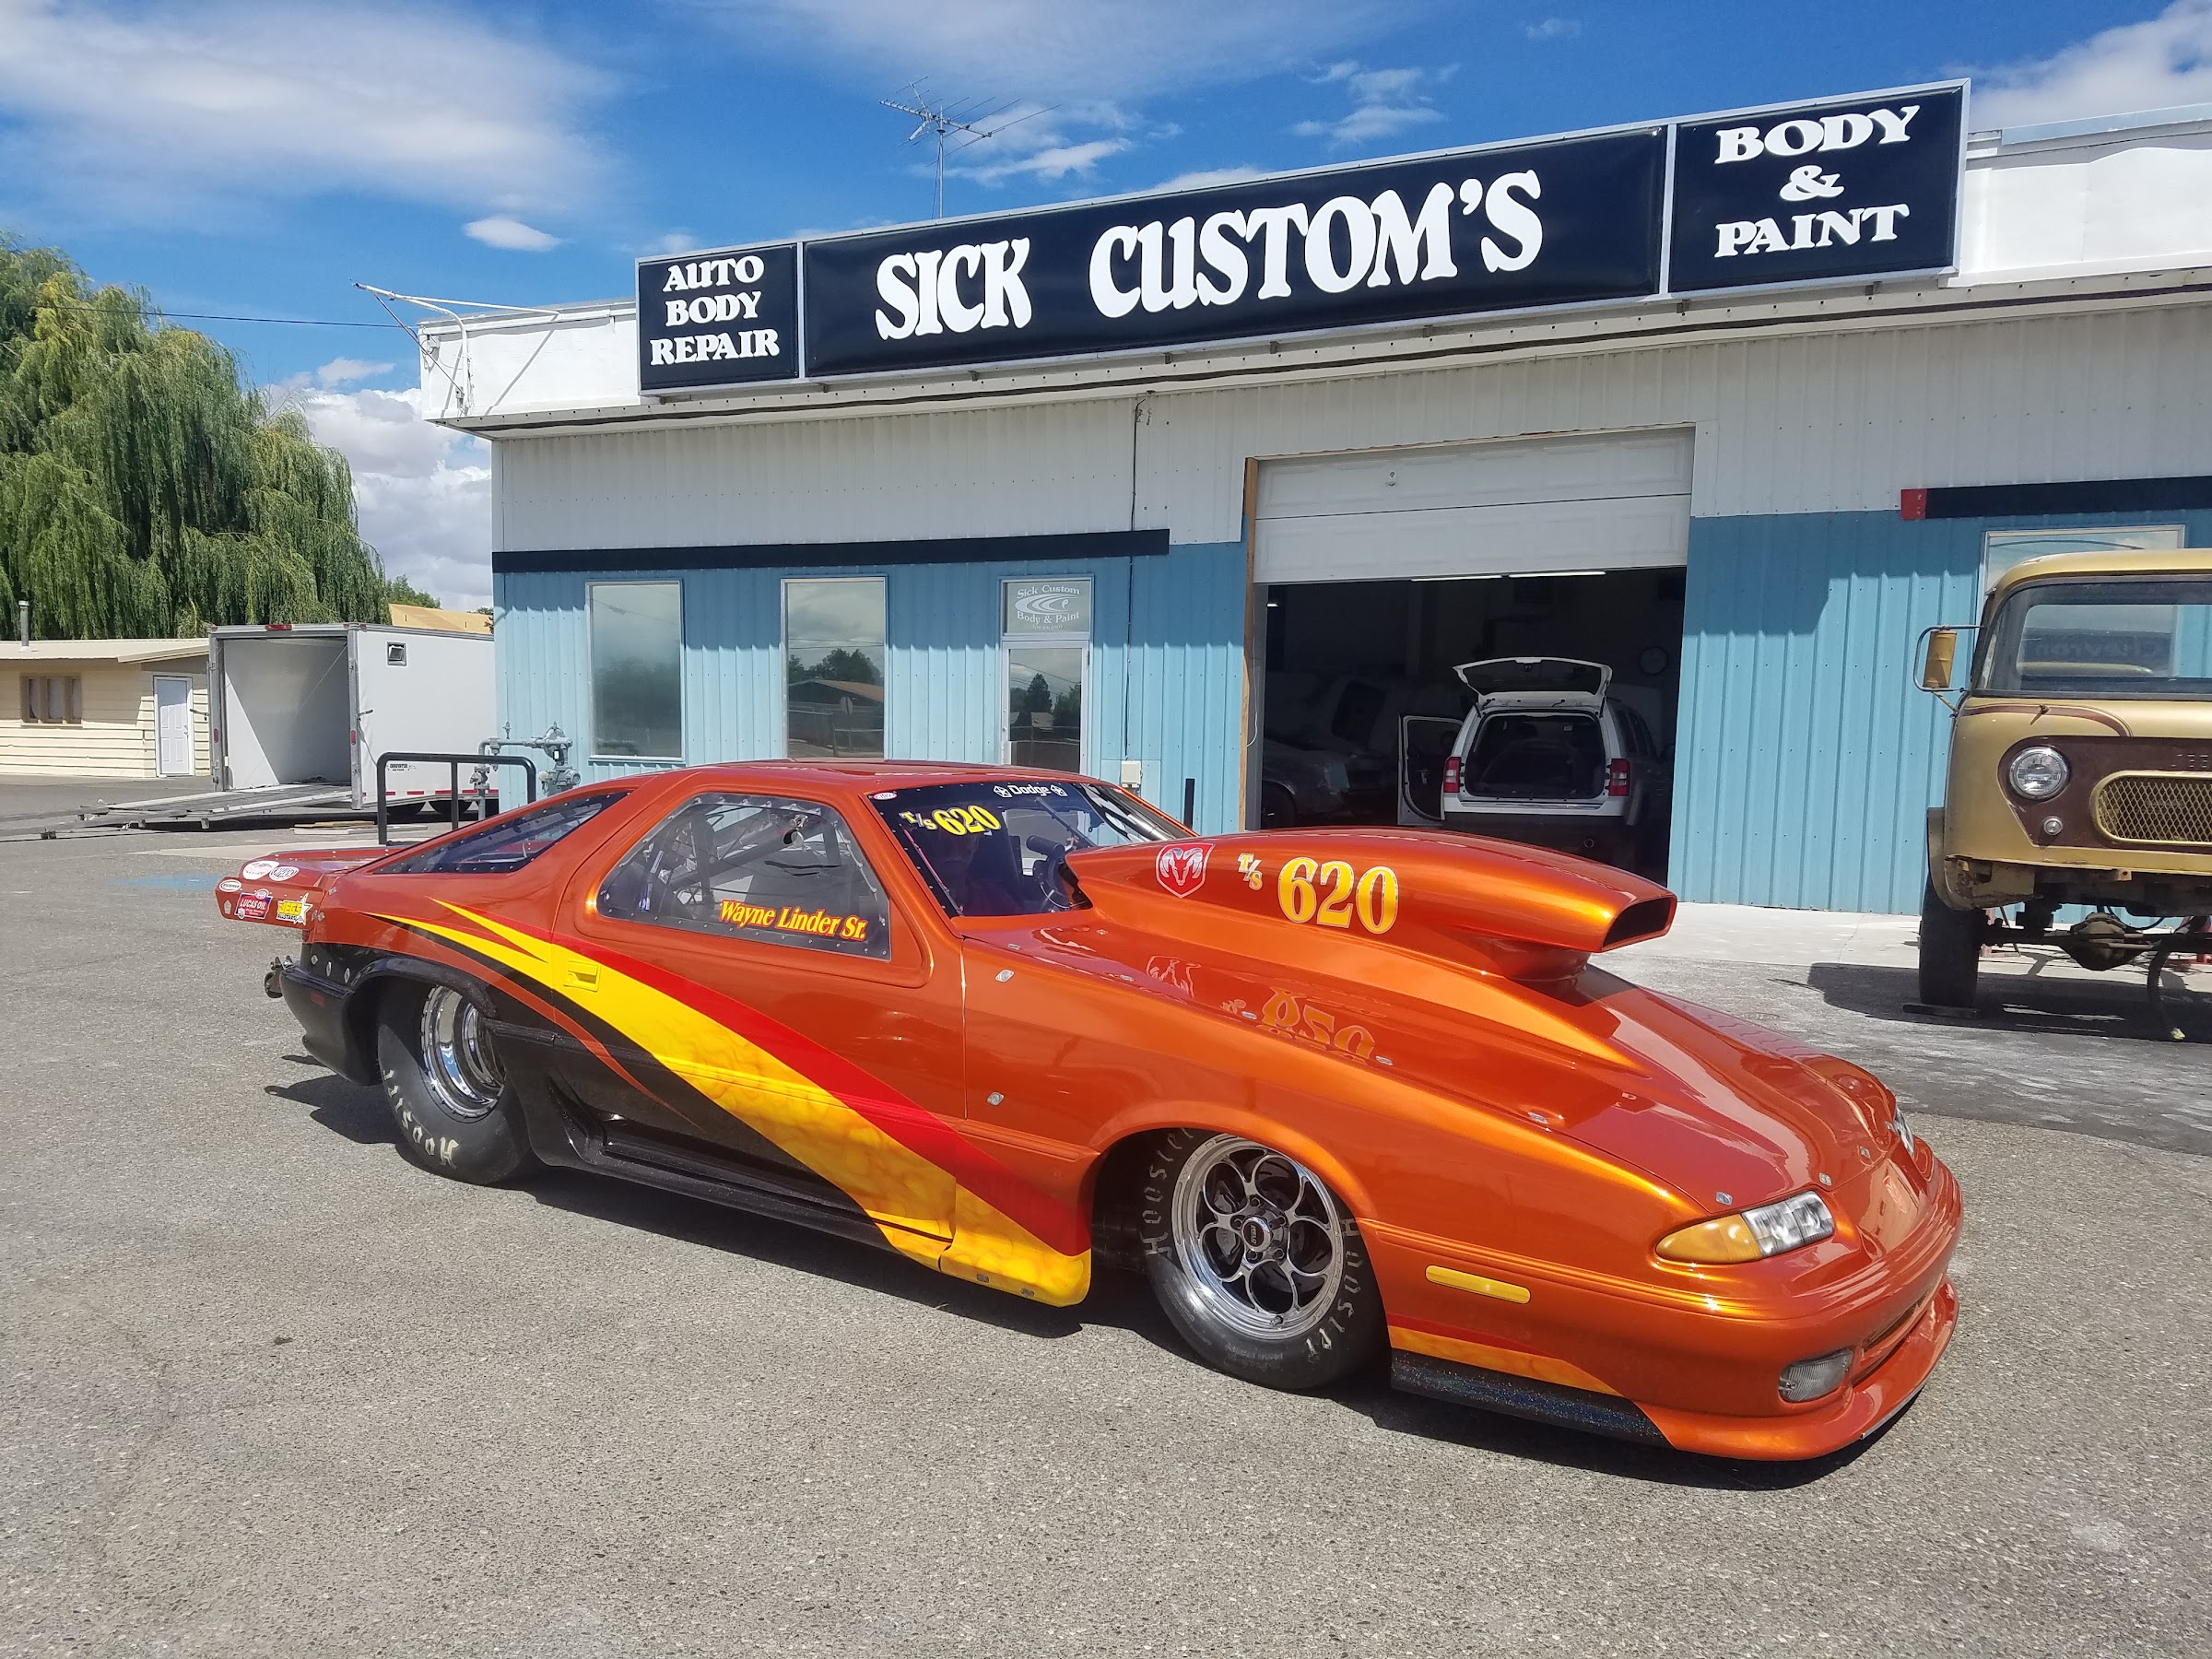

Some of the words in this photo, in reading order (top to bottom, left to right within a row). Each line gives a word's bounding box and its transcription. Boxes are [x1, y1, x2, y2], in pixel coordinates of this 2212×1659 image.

[1714, 105, 1920, 164] BODY
[1780, 165, 1844, 201] &
[1714, 204, 1911, 257] PAINT
[875, 237, 1032, 341] SICK
[1089, 169, 1544, 318] CUSTOM'S
[662, 255, 765, 294] AUTO
[665, 290, 762, 327] BODY
[650, 328, 781, 367] REPAIR
[1017, 586, 1039, 599] Sick
[1041, 585, 1080, 595] Custom
[1017, 610, 1041, 625] Body
[1043, 615, 1053, 624] &
[1055, 612, 1080, 624] Paint
[1008, 784, 1052, 796] Dodge
[899, 810, 937, 830] T/S
[931, 804, 1001, 836] 620
[240, 898, 257, 909] LUCAS
[257, 900, 266, 911] OIL
[1237, 853, 1264, 891] T/S
[1277, 856, 1400, 935] 620
[719, 899, 776, 928] Wayne
[775, 906, 841, 937] Linder
[840, 914, 869, 941] Sr.
